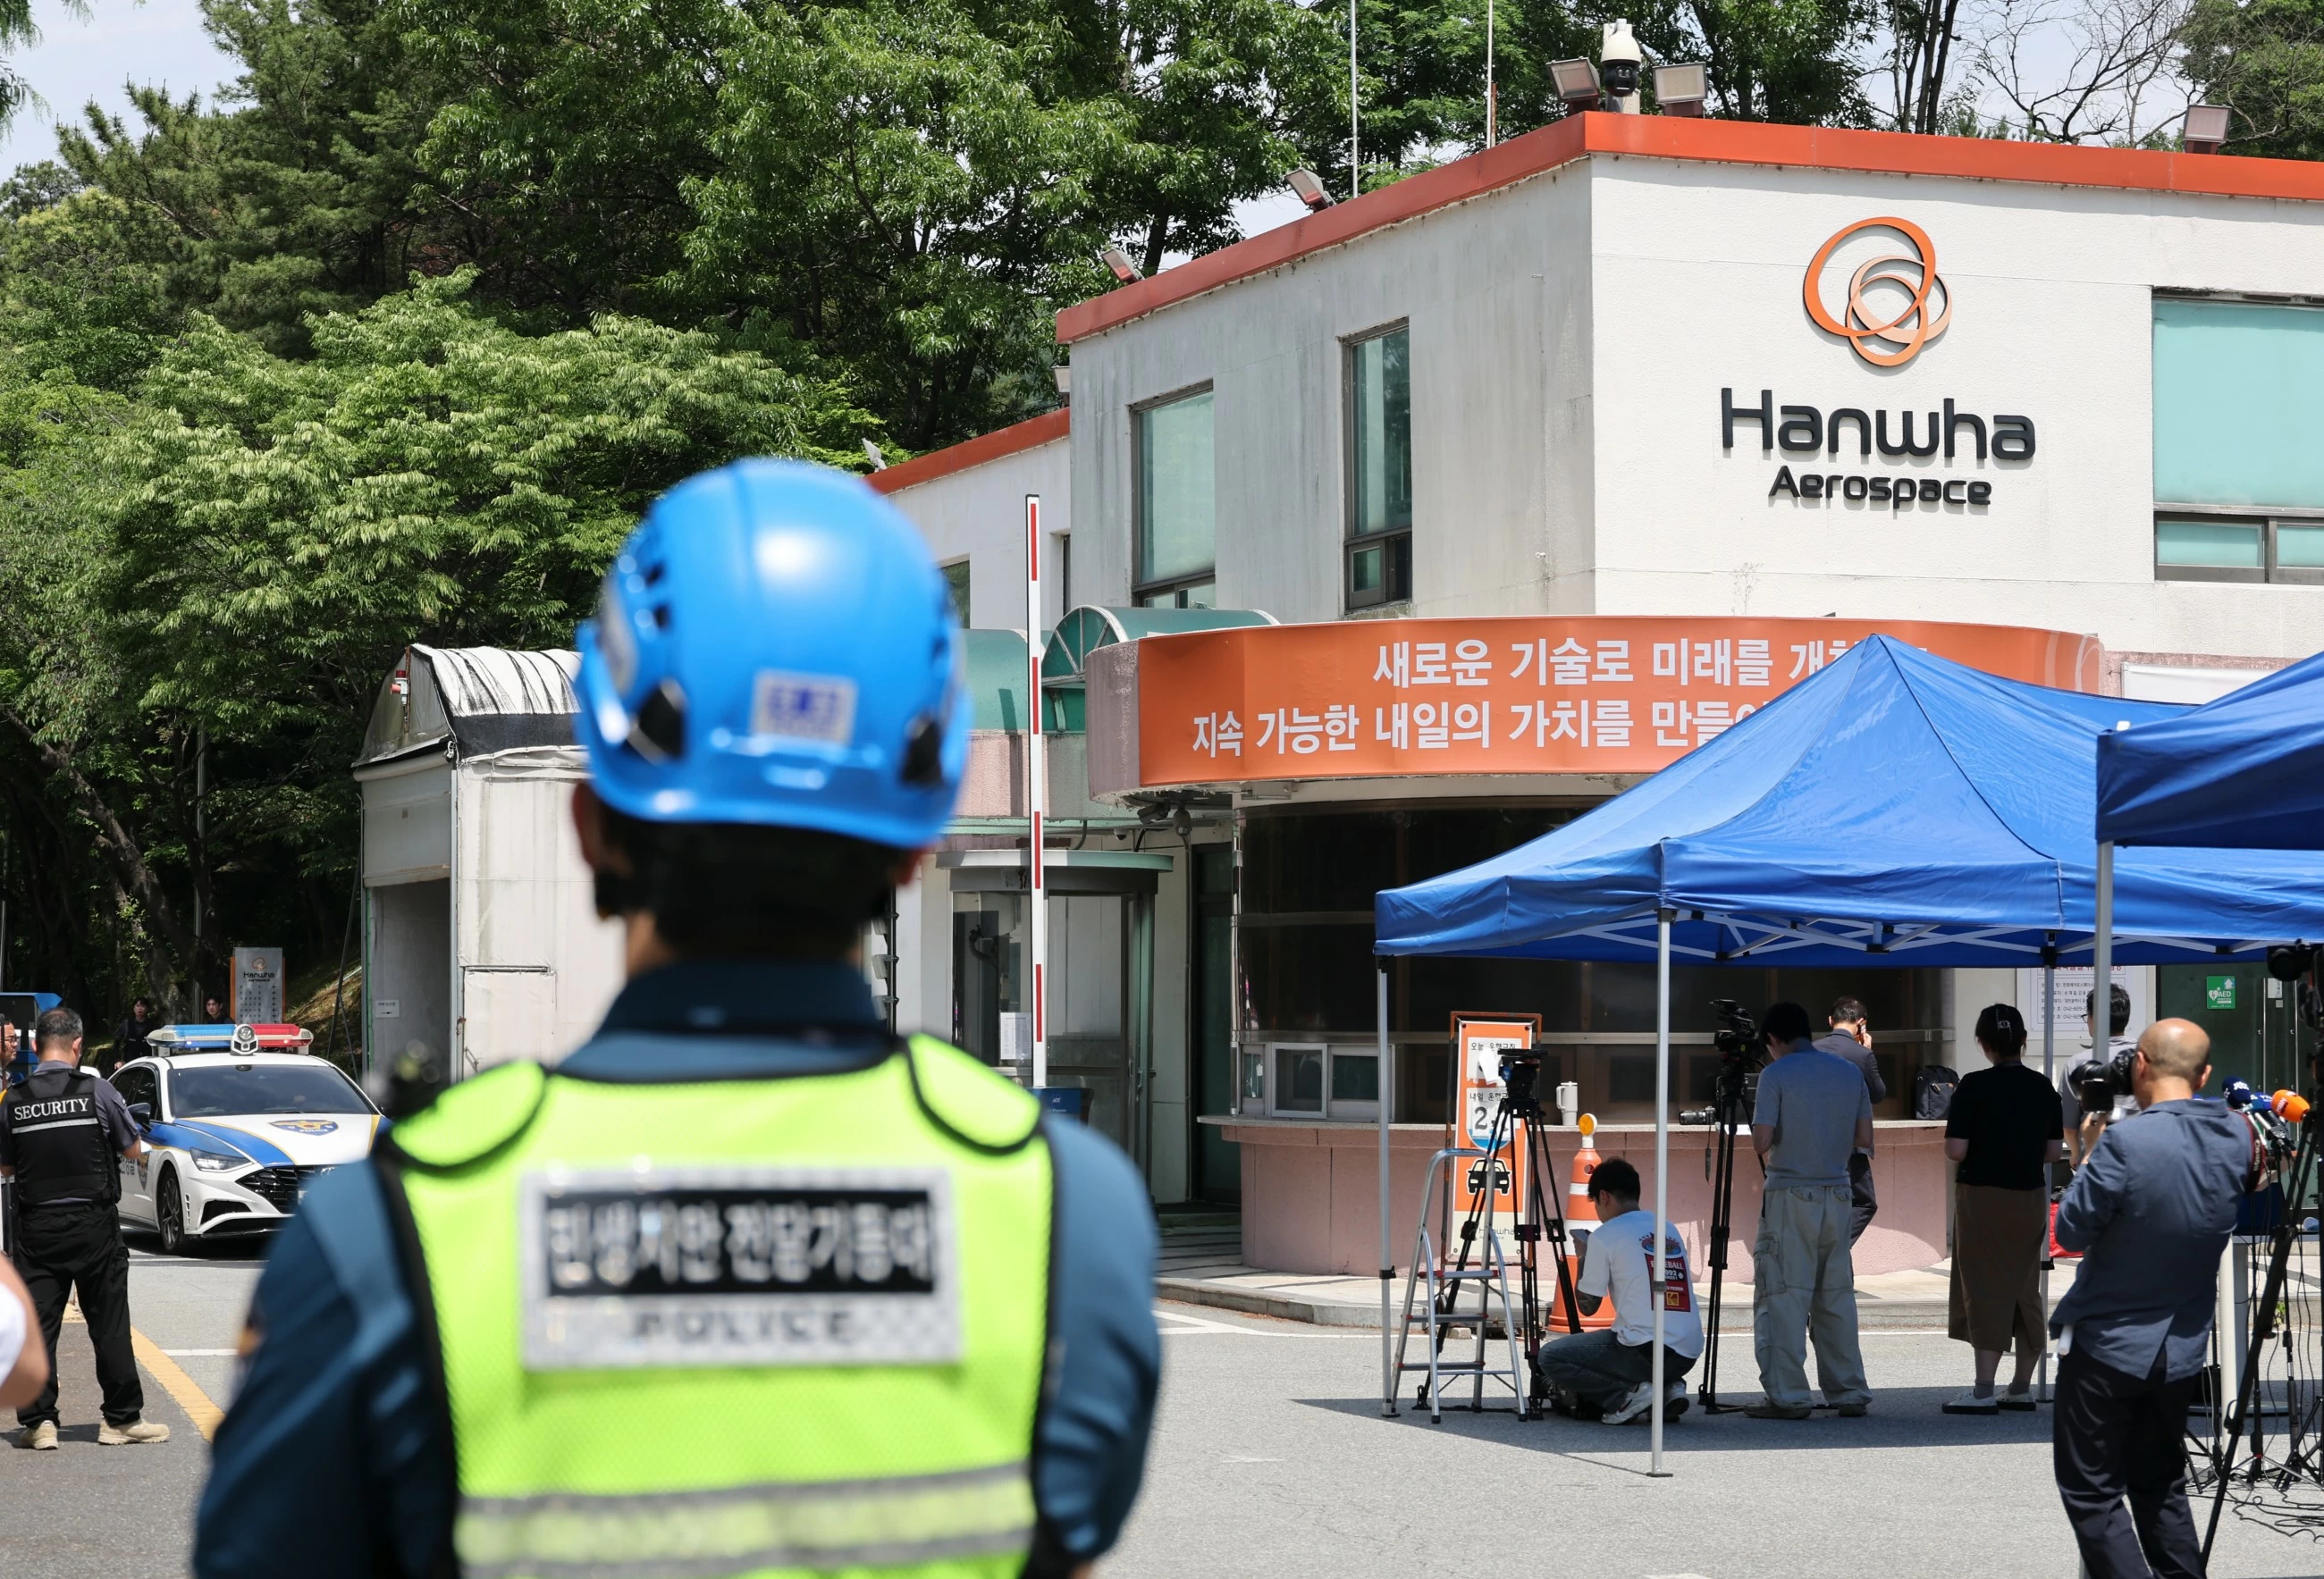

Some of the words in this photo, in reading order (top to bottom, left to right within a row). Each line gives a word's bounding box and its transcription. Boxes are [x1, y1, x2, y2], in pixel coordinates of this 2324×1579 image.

[1722, 387, 2036, 460] Hanwha
[1768, 466, 1992, 509] Aerospace
[1373, 639, 1493, 688] 새로운
[1510, 637, 1634, 686] 기술로
[1653, 638, 1773, 686] 미래를
[1192, 710, 1243, 758] 지속
[1256, 704, 1360, 754] 가능한
[1376, 701, 1490, 750] 내일의
[1508, 700, 1634, 747] 가치를
[14, 1098, 89, 1121] SECURITY
[1478, 1227, 1515, 1235] Hwha
[635, 1311, 854, 1341] POLICE
